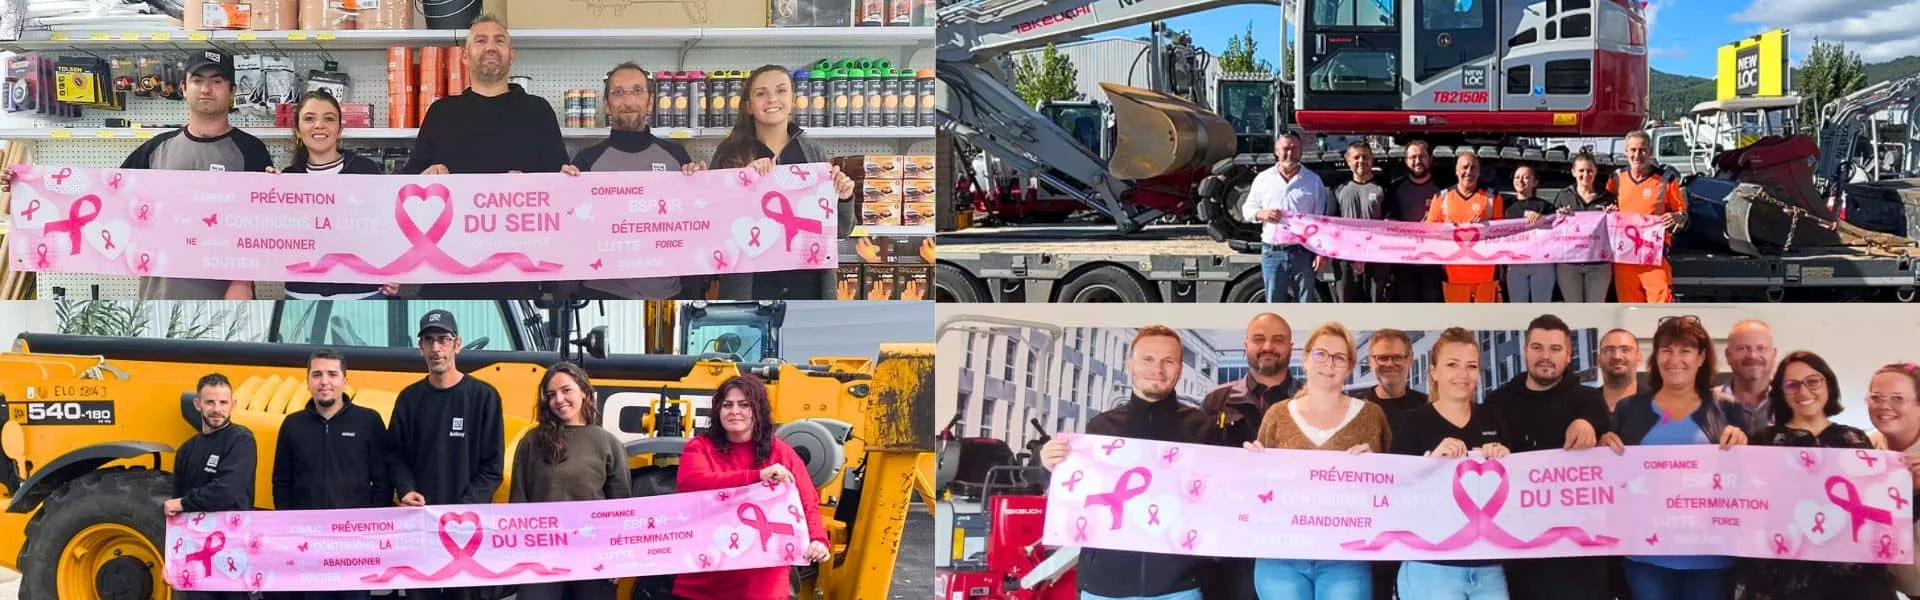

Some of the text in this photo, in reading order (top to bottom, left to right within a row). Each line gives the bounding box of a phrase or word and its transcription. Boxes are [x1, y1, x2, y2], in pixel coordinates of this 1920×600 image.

[1738, 54, 1757, 70] NEW
[1464, 69, 1483, 77] NEW
[1738, 69, 1757, 89] LOC
[1464, 76, 1483, 86] LOC
[1433, 91, 1488, 103] TB2150R
[250, 188, 335, 205] PRÉVENTION
[591, 187, 644, 196] CONFIANCE
[473, 191, 550, 208] CANCER
[315, 217, 331, 230] LA
[464, 212, 560, 233] DU SEIN
[611, 220, 711, 234] DÉTERMINATION
[186, 237, 198, 246] NE
[237, 238, 316, 250] ABANDONNER
[655, 240, 684, 248] FORCE
[28, 403, 111, 420] 540-180
[1643, 461, 1698, 469] CONFIANCE
[1309, 467, 1394, 484] PRÉVENTION
[1528, 466, 1603, 483] CANCER
[1373, 495, 1390, 508] LA
[1520, 486, 1615, 508] DU SEIN
[1665, 495, 1769, 510] DÉTERMINATION
[591, 509, 636, 519] CONFIANCE
[1238, 513, 1373, 528] NE ABANDONNER
[332, 520, 394, 532] PRÉVENTION
[498, 516, 559, 530] CANCER
[379, 539, 391, 550] LA
[492, 532, 568, 548] DU SEIN
[610, 530, 694, 546] DÉTERMINATION
[323, 557, 381, 567] ABANDONNER
